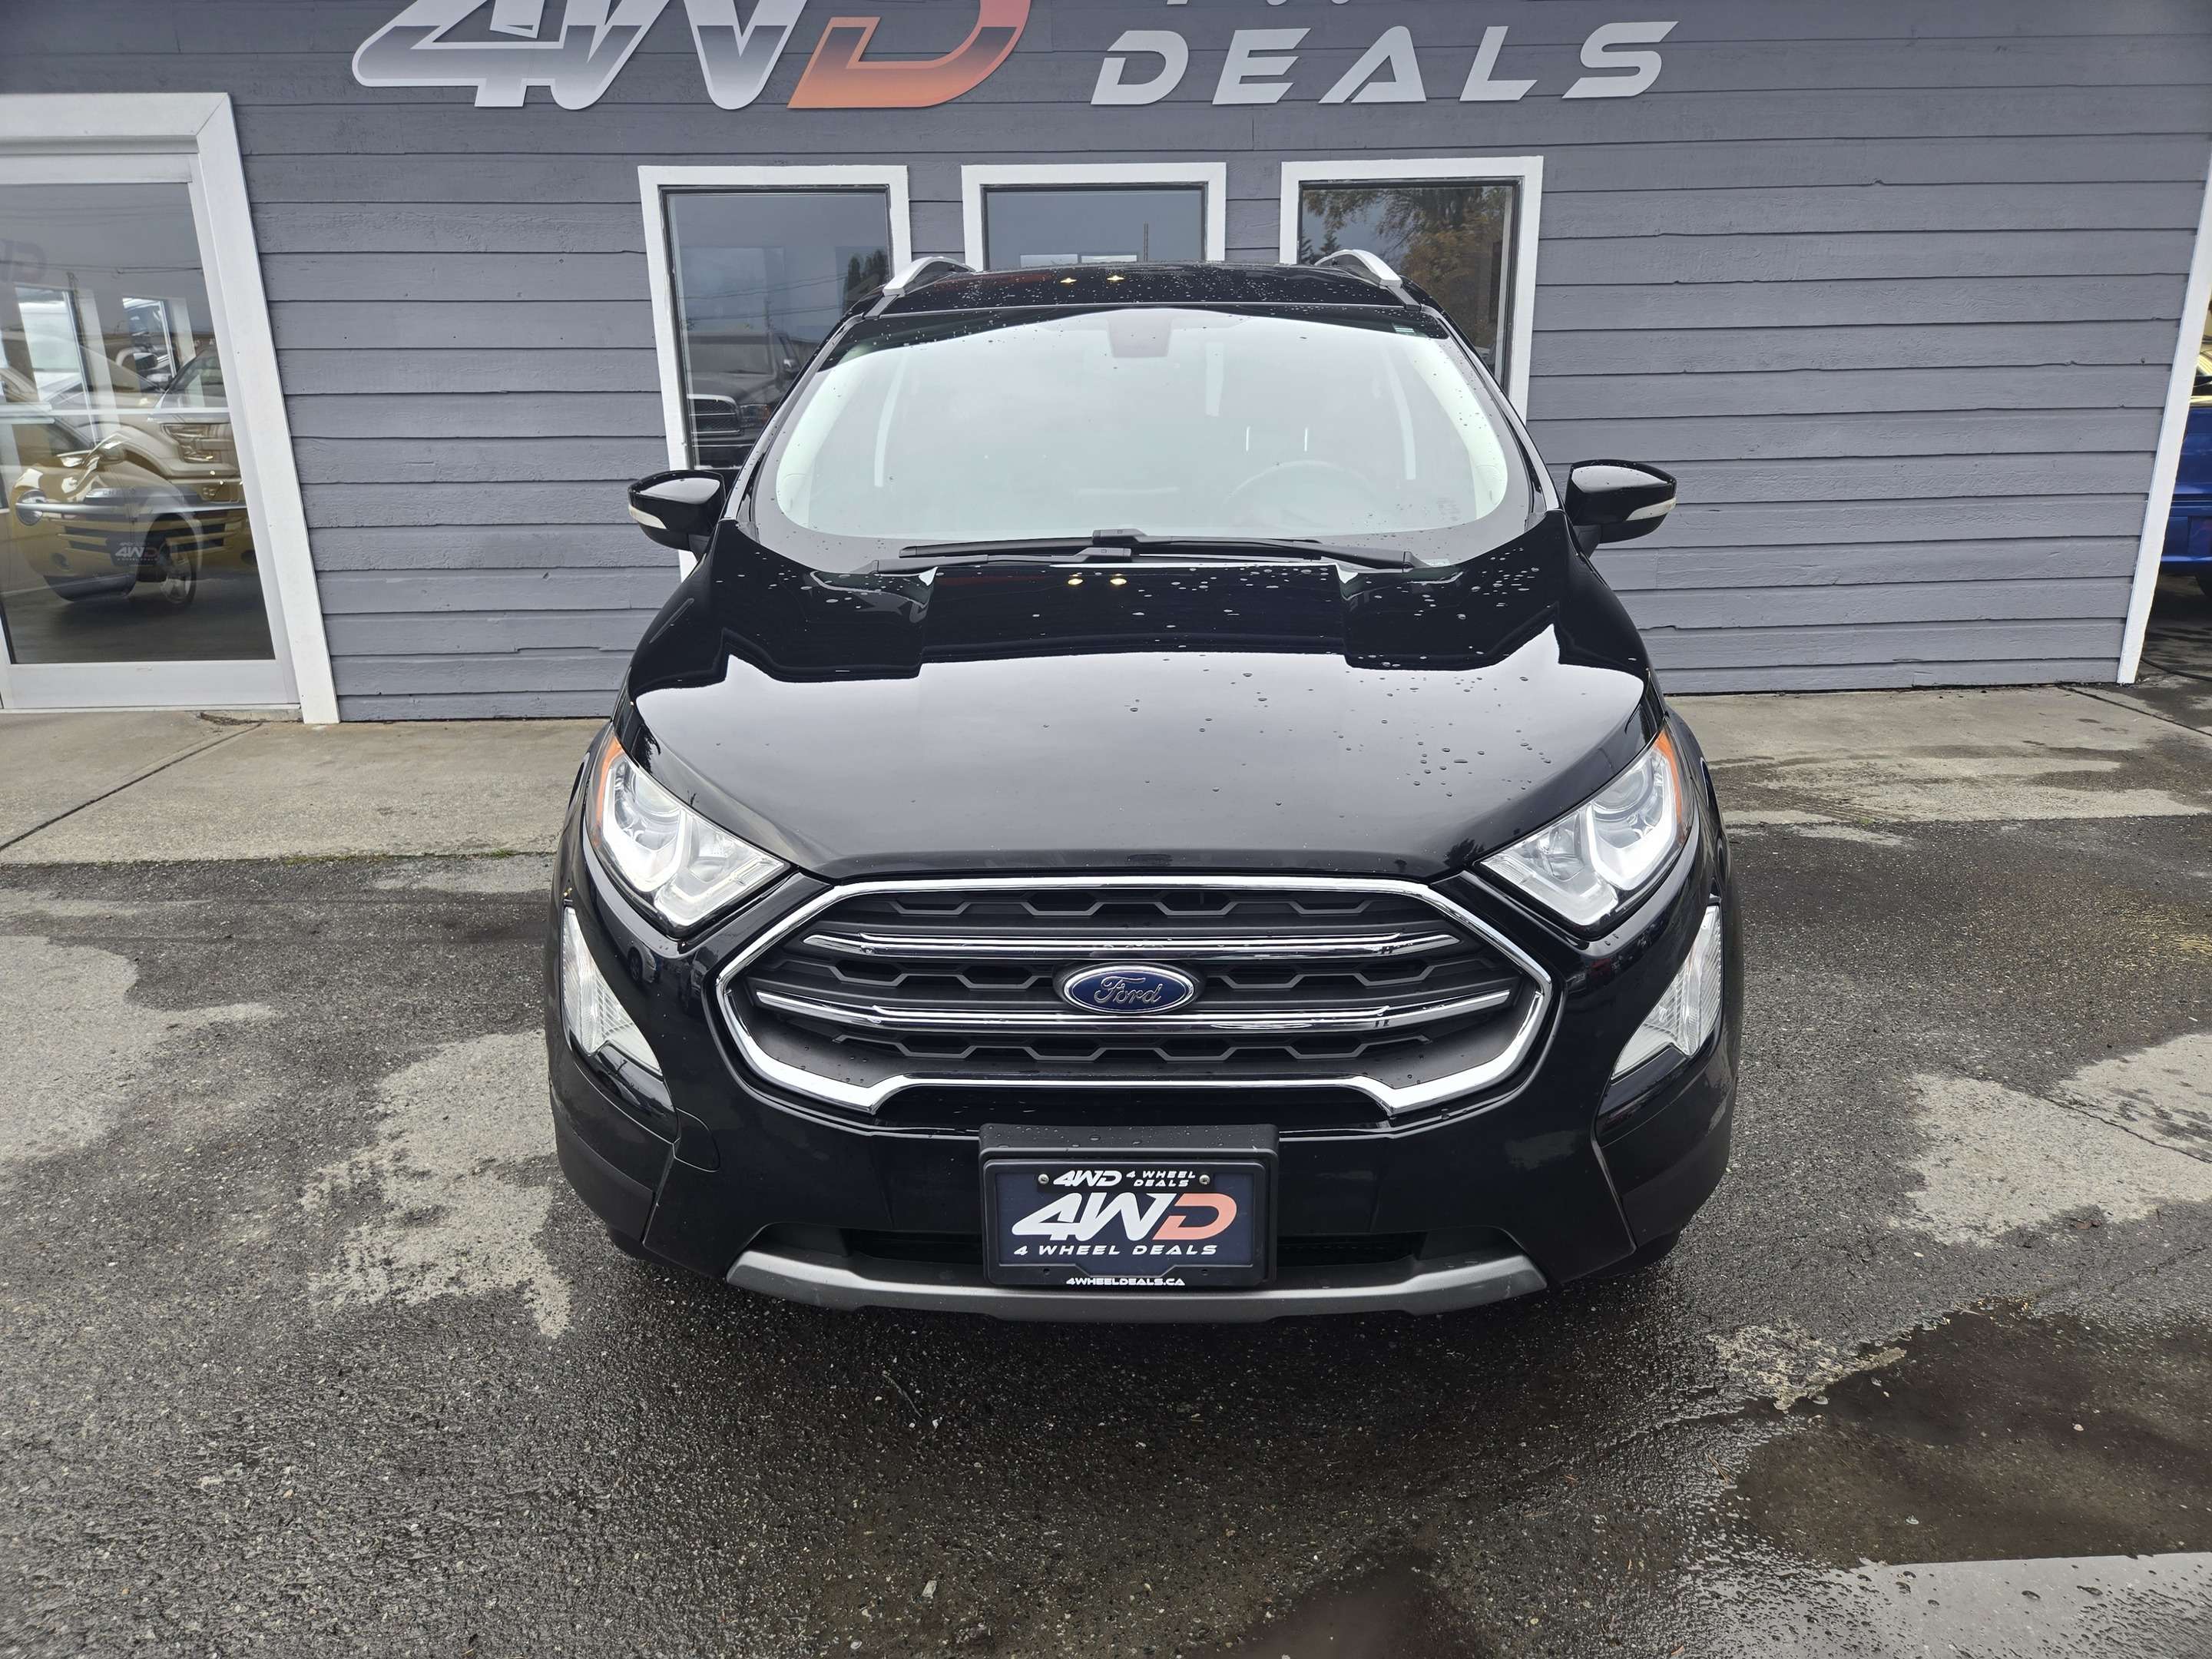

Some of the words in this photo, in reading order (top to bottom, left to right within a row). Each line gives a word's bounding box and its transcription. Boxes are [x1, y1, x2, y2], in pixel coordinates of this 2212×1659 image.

[1091, 21, 1679, 105] DEALS
[1094, 976, 1163, 1005] Ford
[1053, 1170, 1122, 1187] 4WD
[1012, 1192, 1237, 1241] 4WD
[1013, 1245, 1028, 1256] 4
[1038, 1245, 1121, 1256] WHEEL
[1132, 1245, 1218, 1256] DEALS
[1065, 1277, 1186, 1286] 4WHEELDEALS.CA
